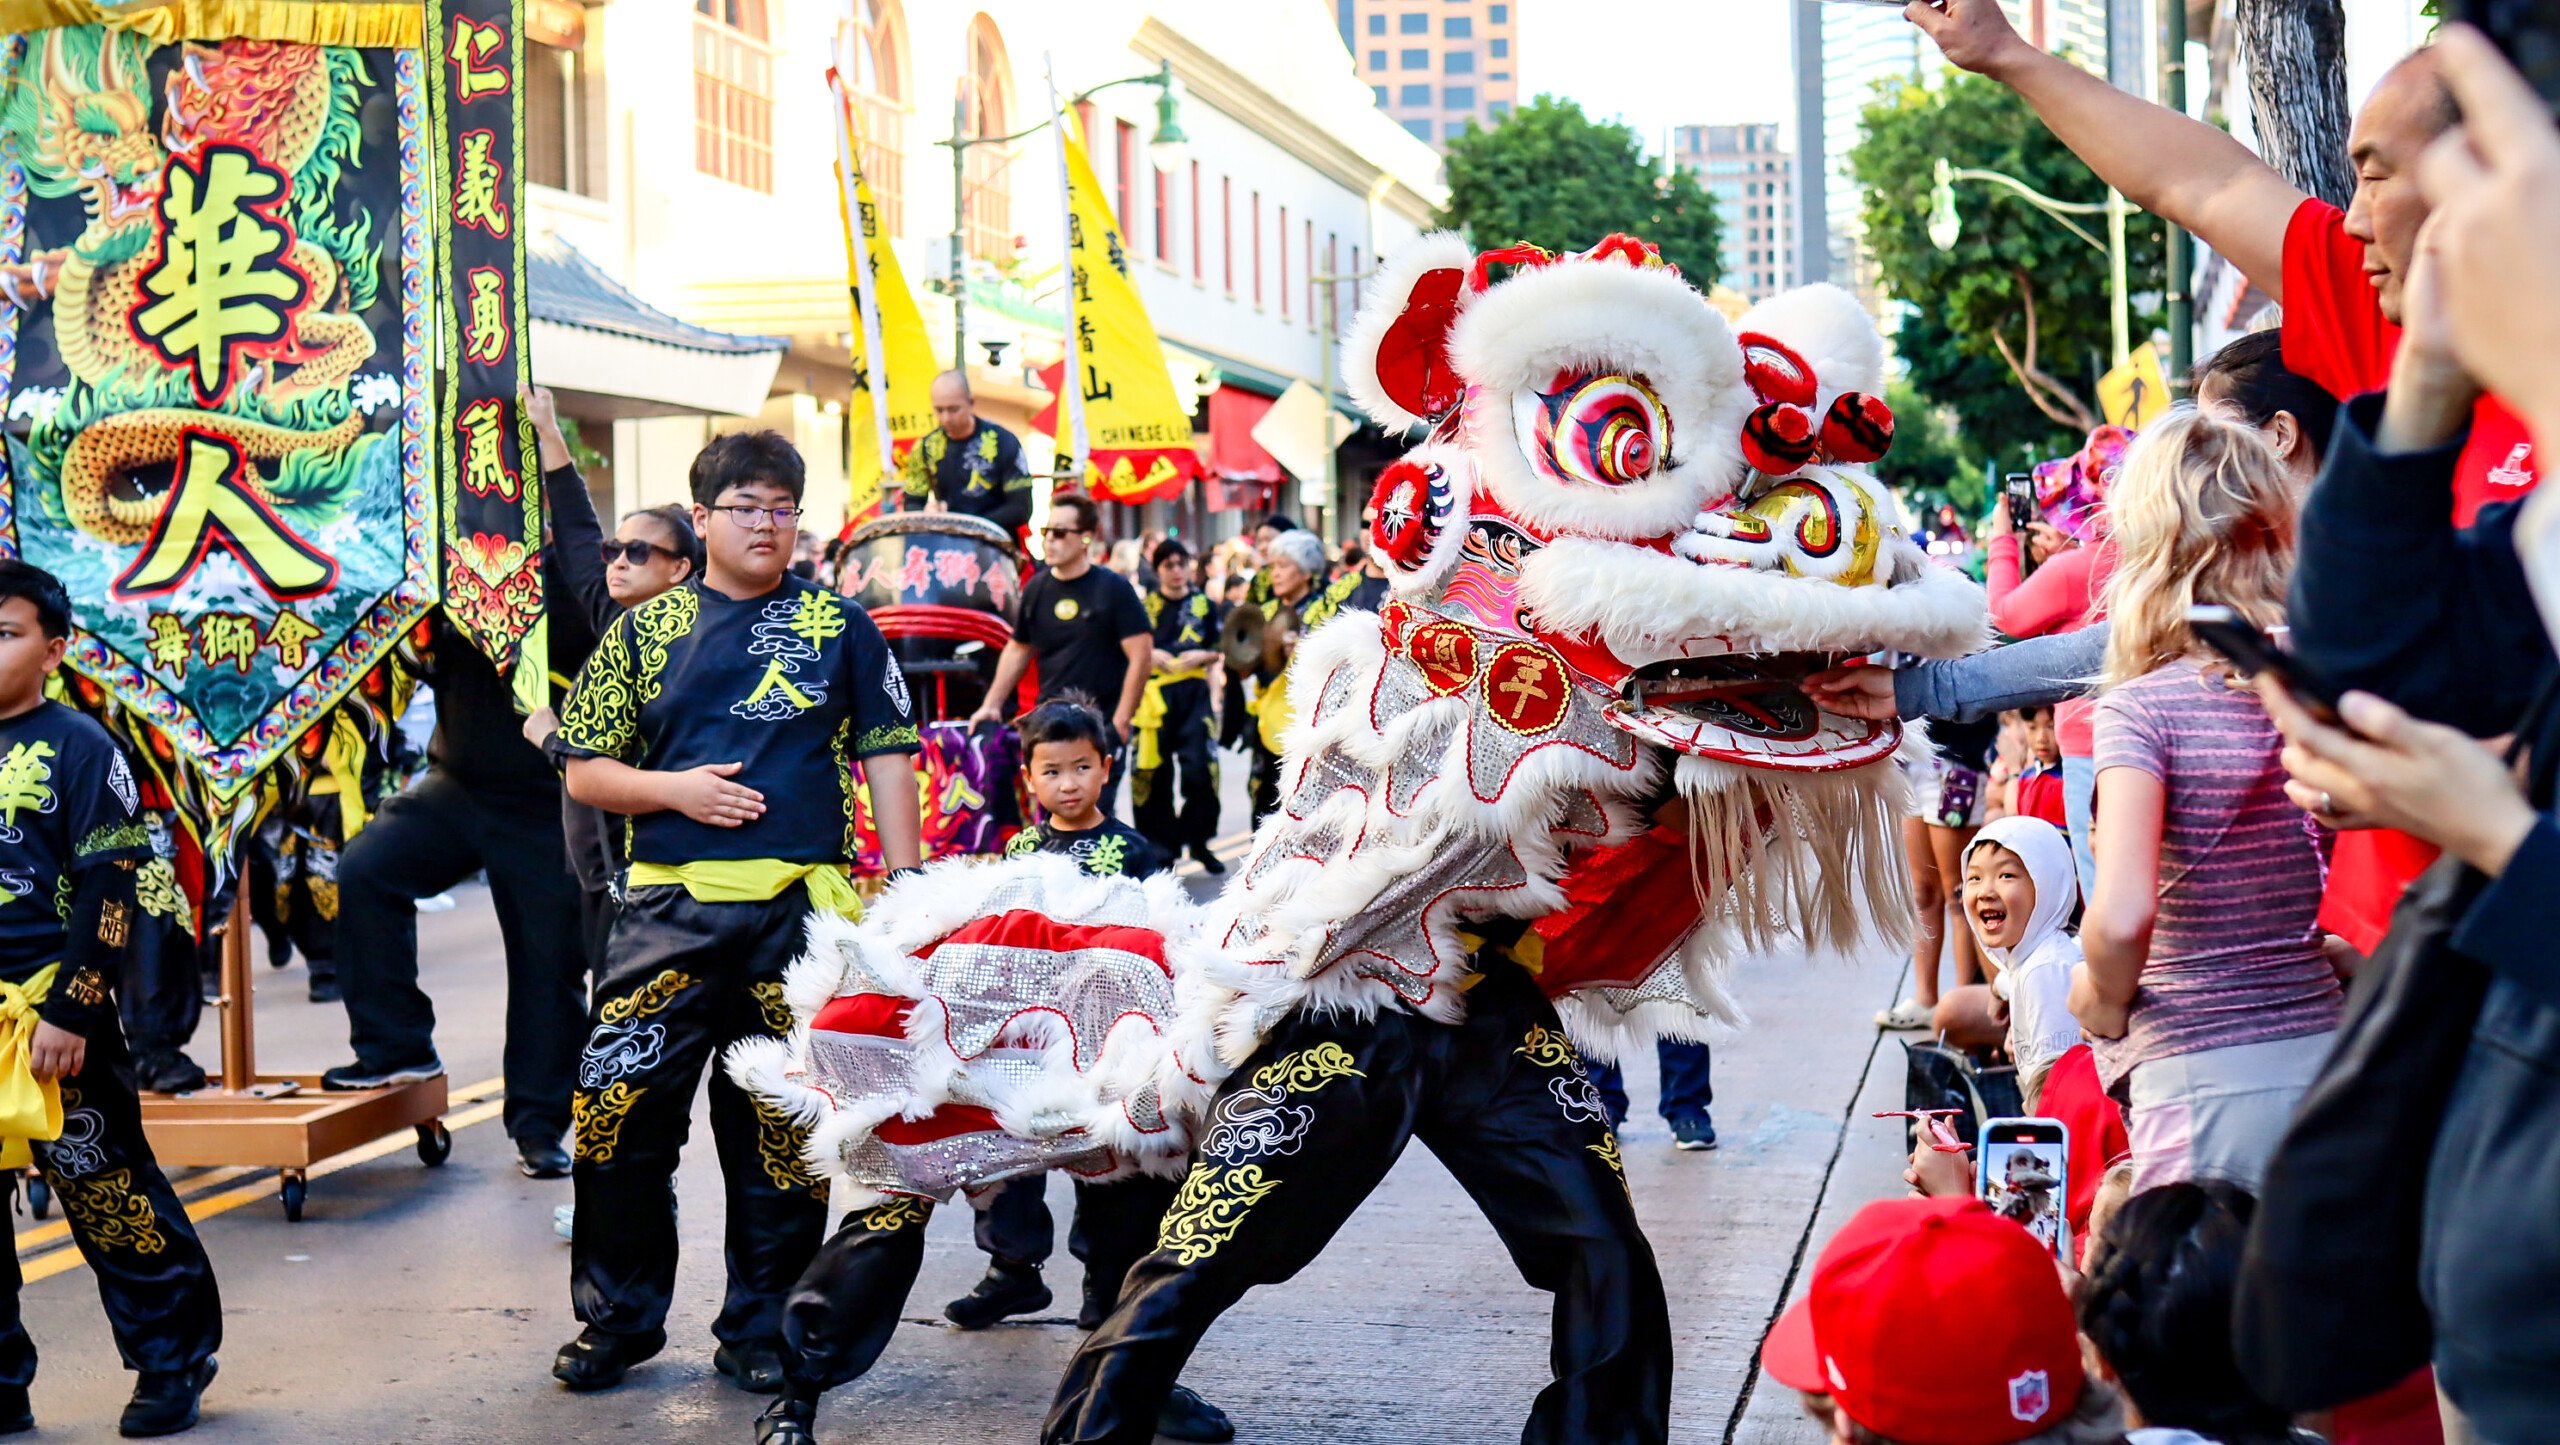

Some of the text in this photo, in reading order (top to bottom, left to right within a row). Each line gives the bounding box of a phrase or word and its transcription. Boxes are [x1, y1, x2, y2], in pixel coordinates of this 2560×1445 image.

[449, 16, 517, 500] 仁義勇氣
[120, 149, 332, 594] 華人
[1101, 424, 1163, 444] CHINESE
[147, 609, 324, 679] 舞獅會
[744, 590, 846, 709] 華人
[1499, 655, 1549, 720] 平
